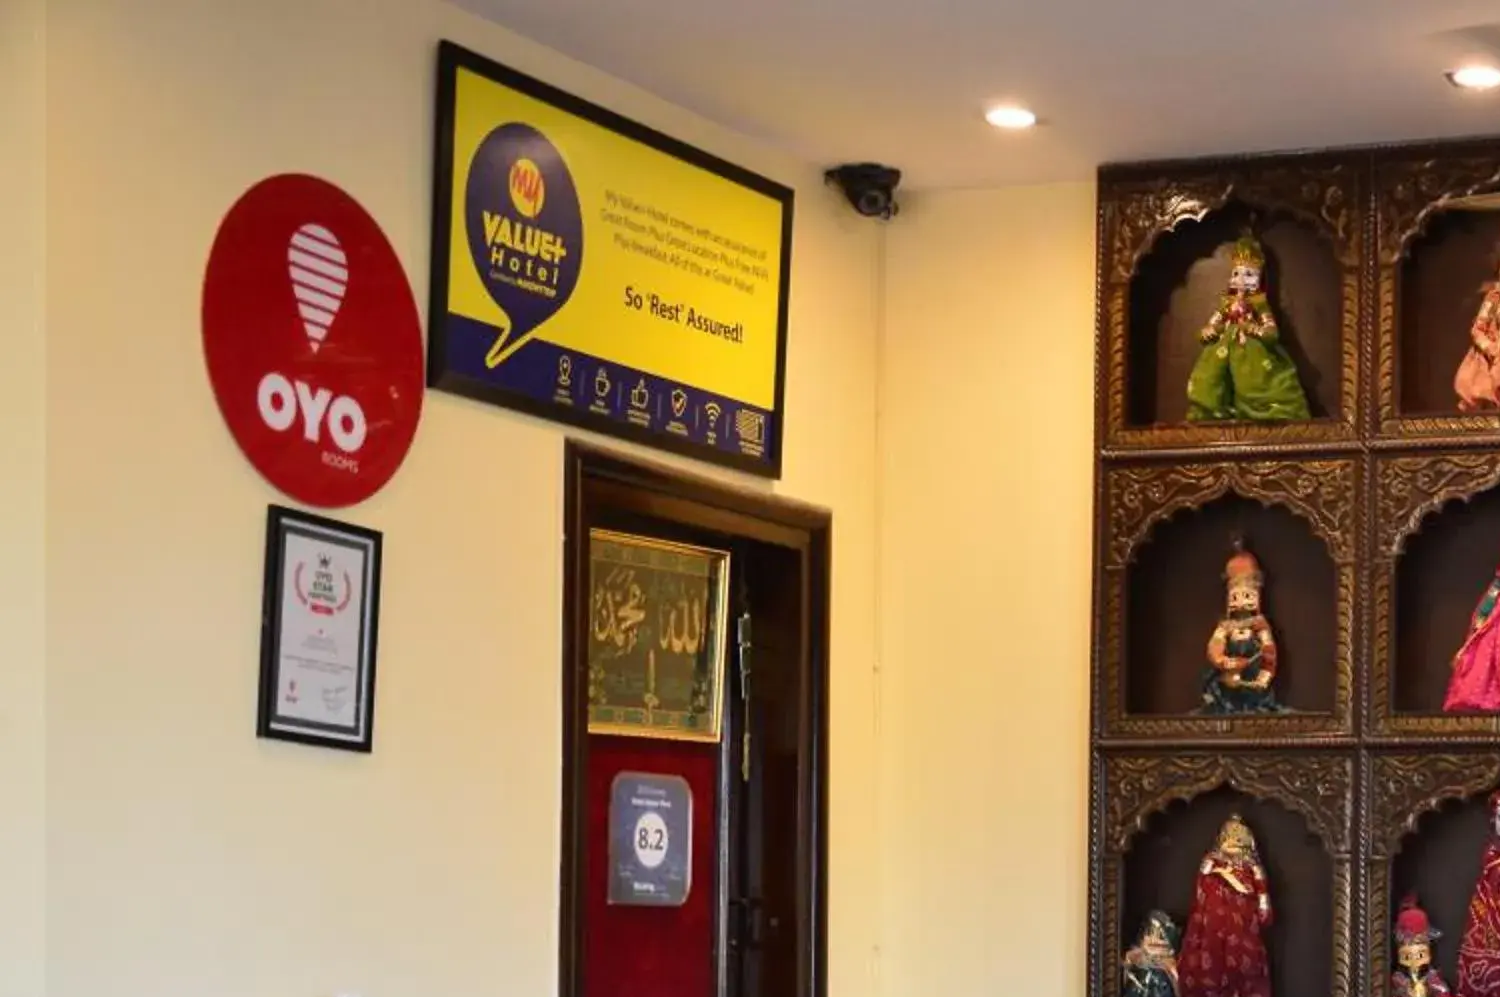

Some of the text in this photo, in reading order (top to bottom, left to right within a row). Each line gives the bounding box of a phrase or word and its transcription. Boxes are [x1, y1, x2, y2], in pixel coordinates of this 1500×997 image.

[491, 246, 560, 285] Hotel
[624, 285, 644, 311] So
[686, 307, 744, 344] Assured!
[257, 372, 368, 454] OYO
[638, 826, 665, 851] 8.2
